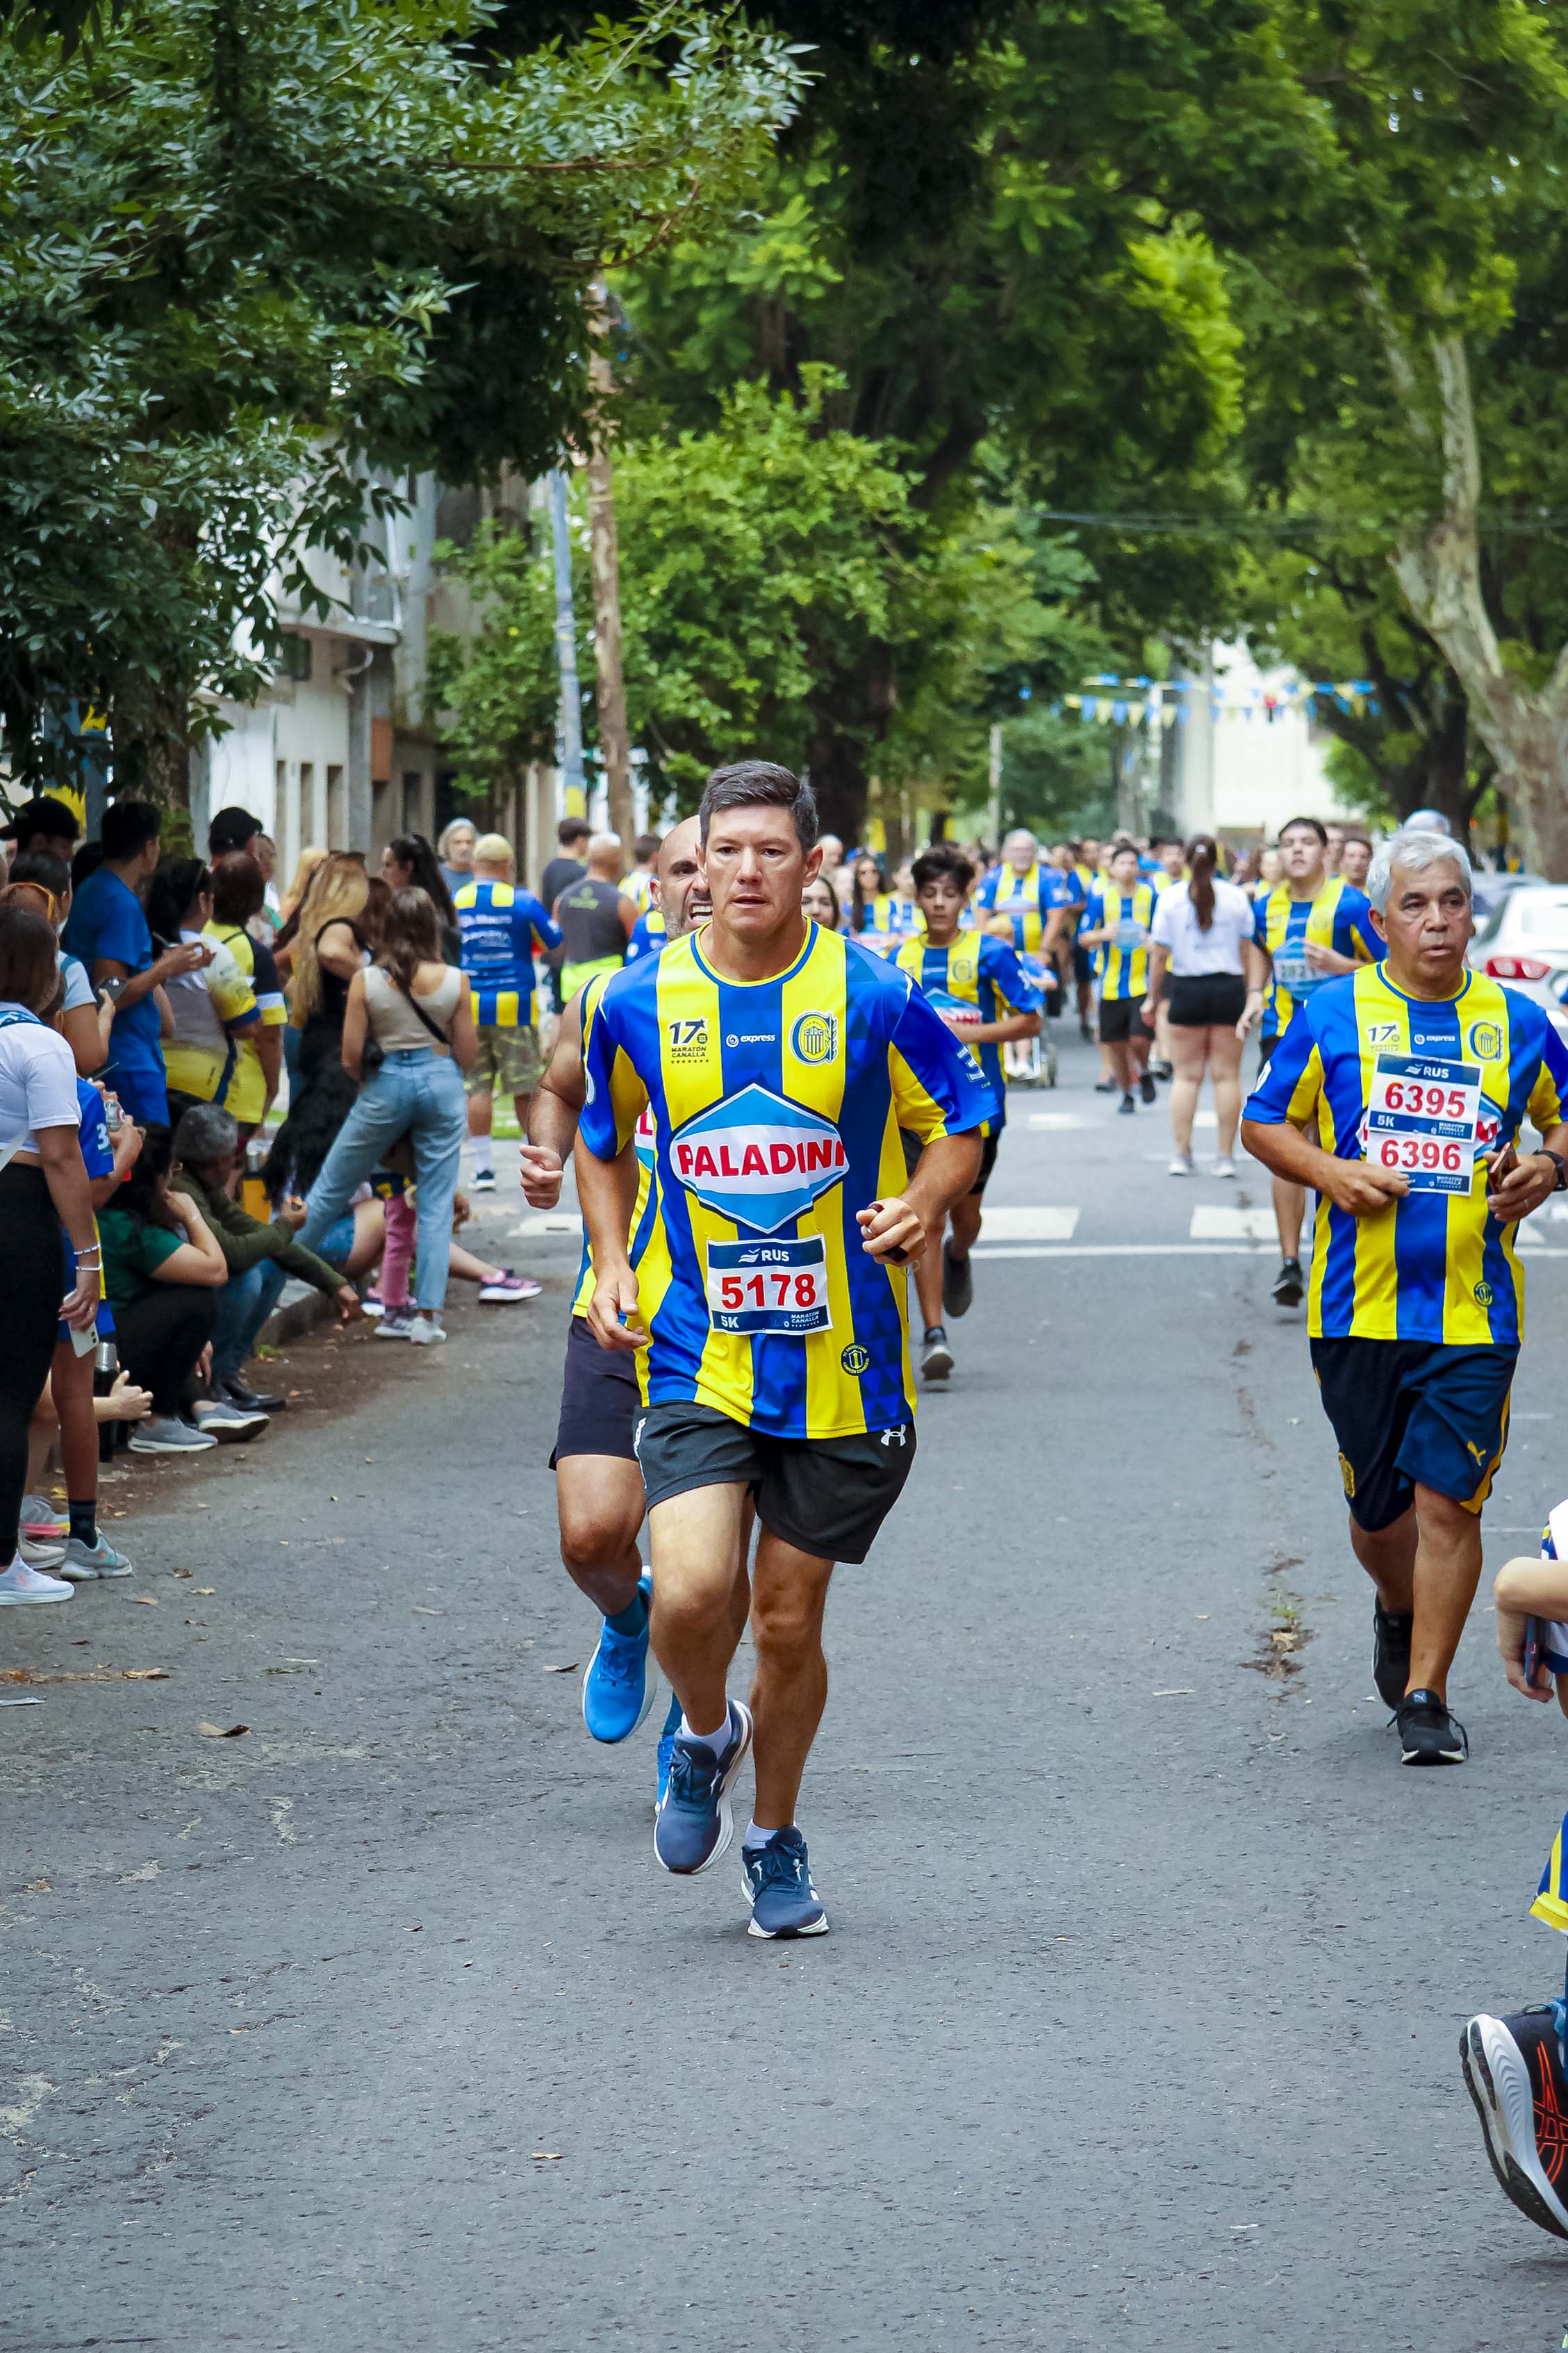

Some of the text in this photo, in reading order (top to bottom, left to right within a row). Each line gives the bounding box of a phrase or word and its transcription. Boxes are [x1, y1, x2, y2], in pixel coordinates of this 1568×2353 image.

[669, 1019, 706, 1044] 17
[741, 1034, 776, 1044] express
[1368, 1024, 1397, 1042] 17
[1423, 1065, 1449, 1079] RUS
[1385, 1082, 1467, 1118] 6395
[1378, 1115, 1394, 1127] 5K
[677, 1139, 845, 1177] PALADINI
[1381, 1139, 1461, 1171] 6396
[761, 1250, 789, 1261] RUS
[722, 1273, 816, 1309] 5178
[720, 1315, 739, 1328] 5K
